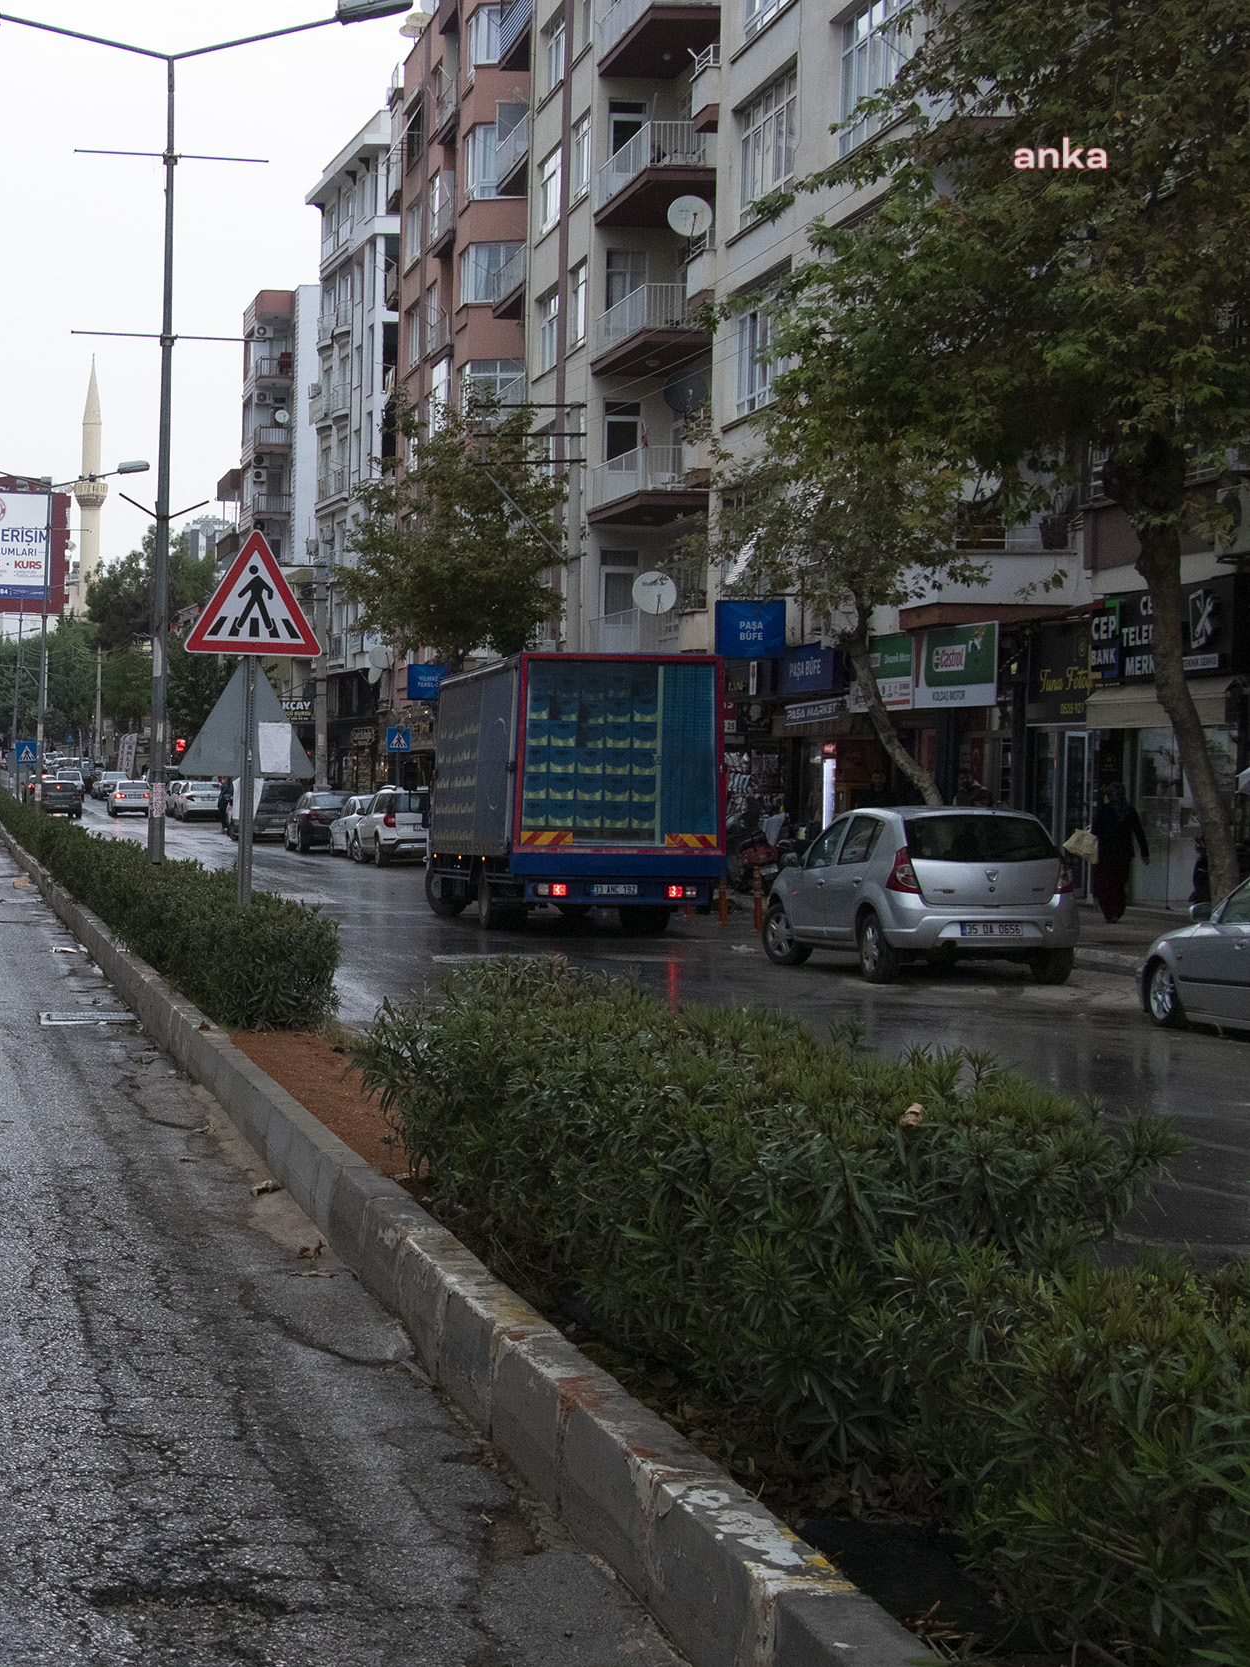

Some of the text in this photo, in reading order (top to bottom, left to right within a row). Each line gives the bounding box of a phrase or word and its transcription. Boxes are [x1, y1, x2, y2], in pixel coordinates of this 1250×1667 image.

[14, 560, 42, 569] KURS
[1139, 595, 1153, 617] CE
[739, 621, 764, 631] PAŞA
[1091, 615, 1116, 641] CEP
[739, 630, 764, 641] BÜFE
[939, 648, 964, 668] Castrol
[1091, 648, 1116, 666] BANK
[789, 656, 821, 680] PAŞA BÜFE
[1039, 668, 1064, 692] Tuna
[282, 701, 311, 711] KÇAY
[806, 702, 838, 717] MARKET
[727, 722, 735, 730] 25
[594, 885, 603, 894] 33
[623, 885, 636, 895] 192
[966, 924, 1021, 935] 35 DA 0656
